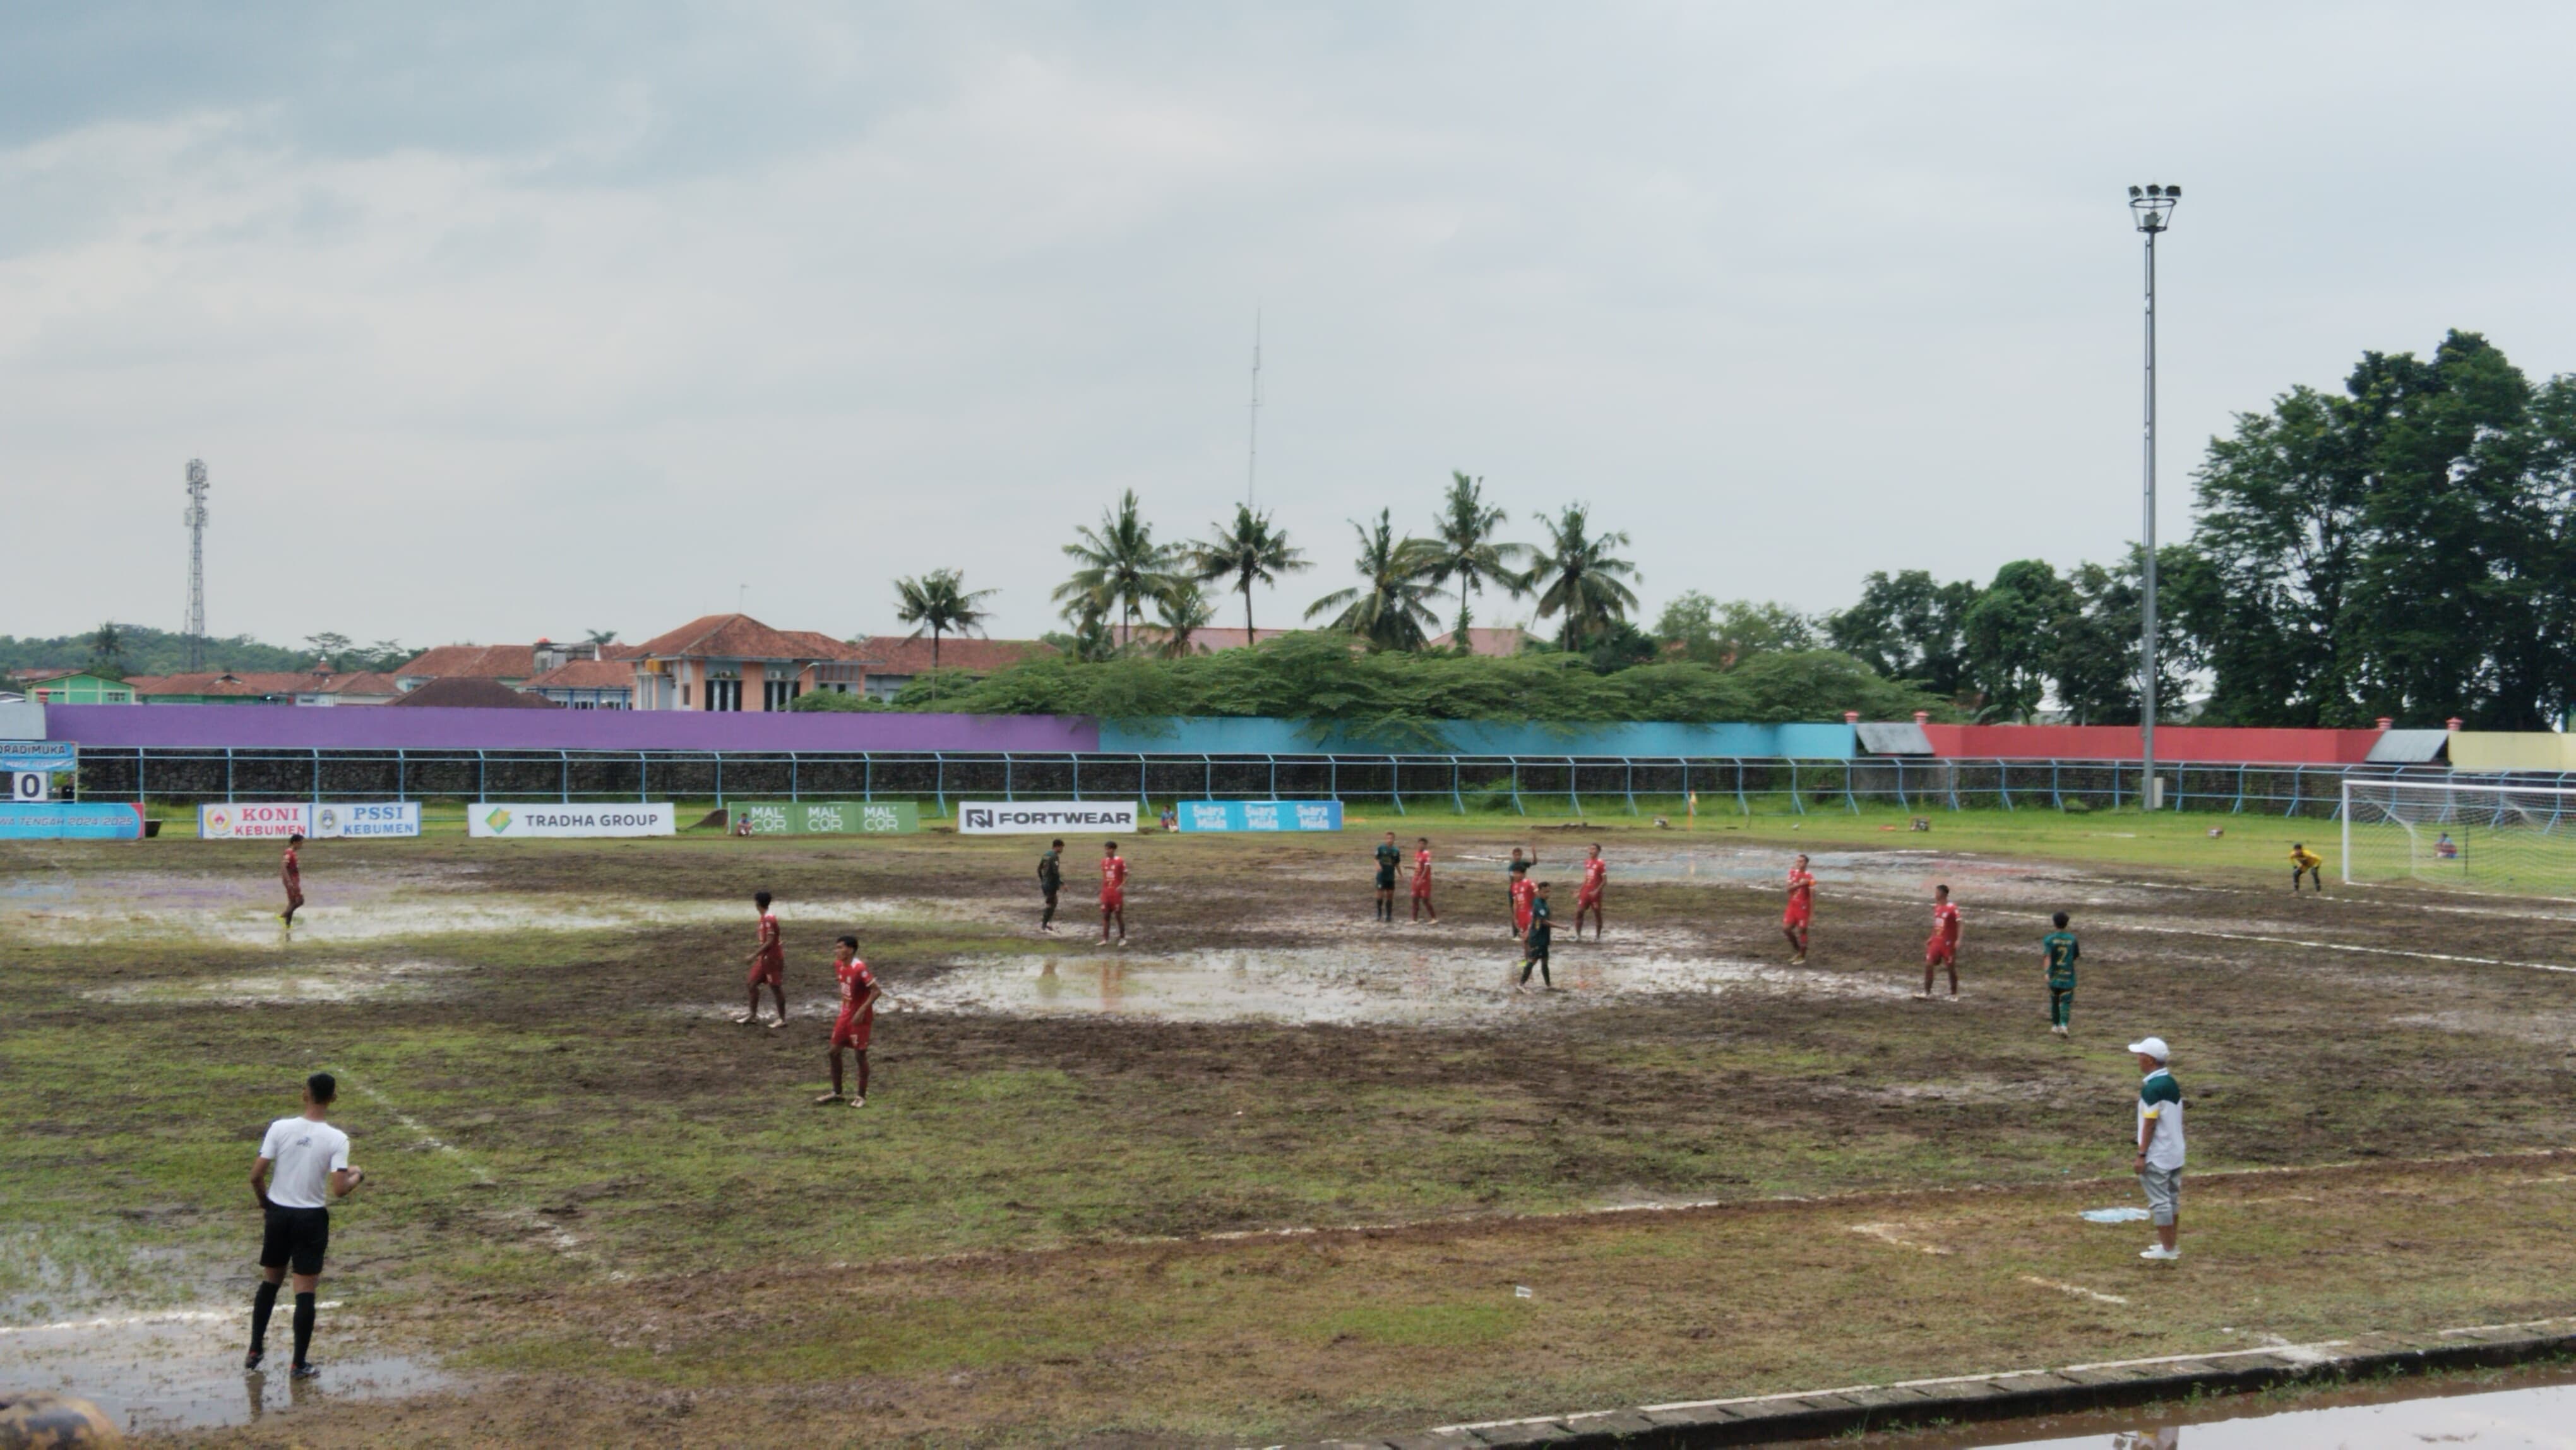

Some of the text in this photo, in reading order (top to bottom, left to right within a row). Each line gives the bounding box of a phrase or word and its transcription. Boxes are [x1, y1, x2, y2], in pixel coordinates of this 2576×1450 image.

[21, 774, 40, 798] 0
[242, 808, 299, 821] KONI
[354, 807, 403, 820] PSSI
[998, 812, 1131, 824] FORTWEAR
[20, 817, 64, 826] TENGAH
[525, 814, 658, 827] TRADHA GROUP
[234, 825, 306, 836] KEBUMEN
[343, 824, 414, 834] KEBUMEN
